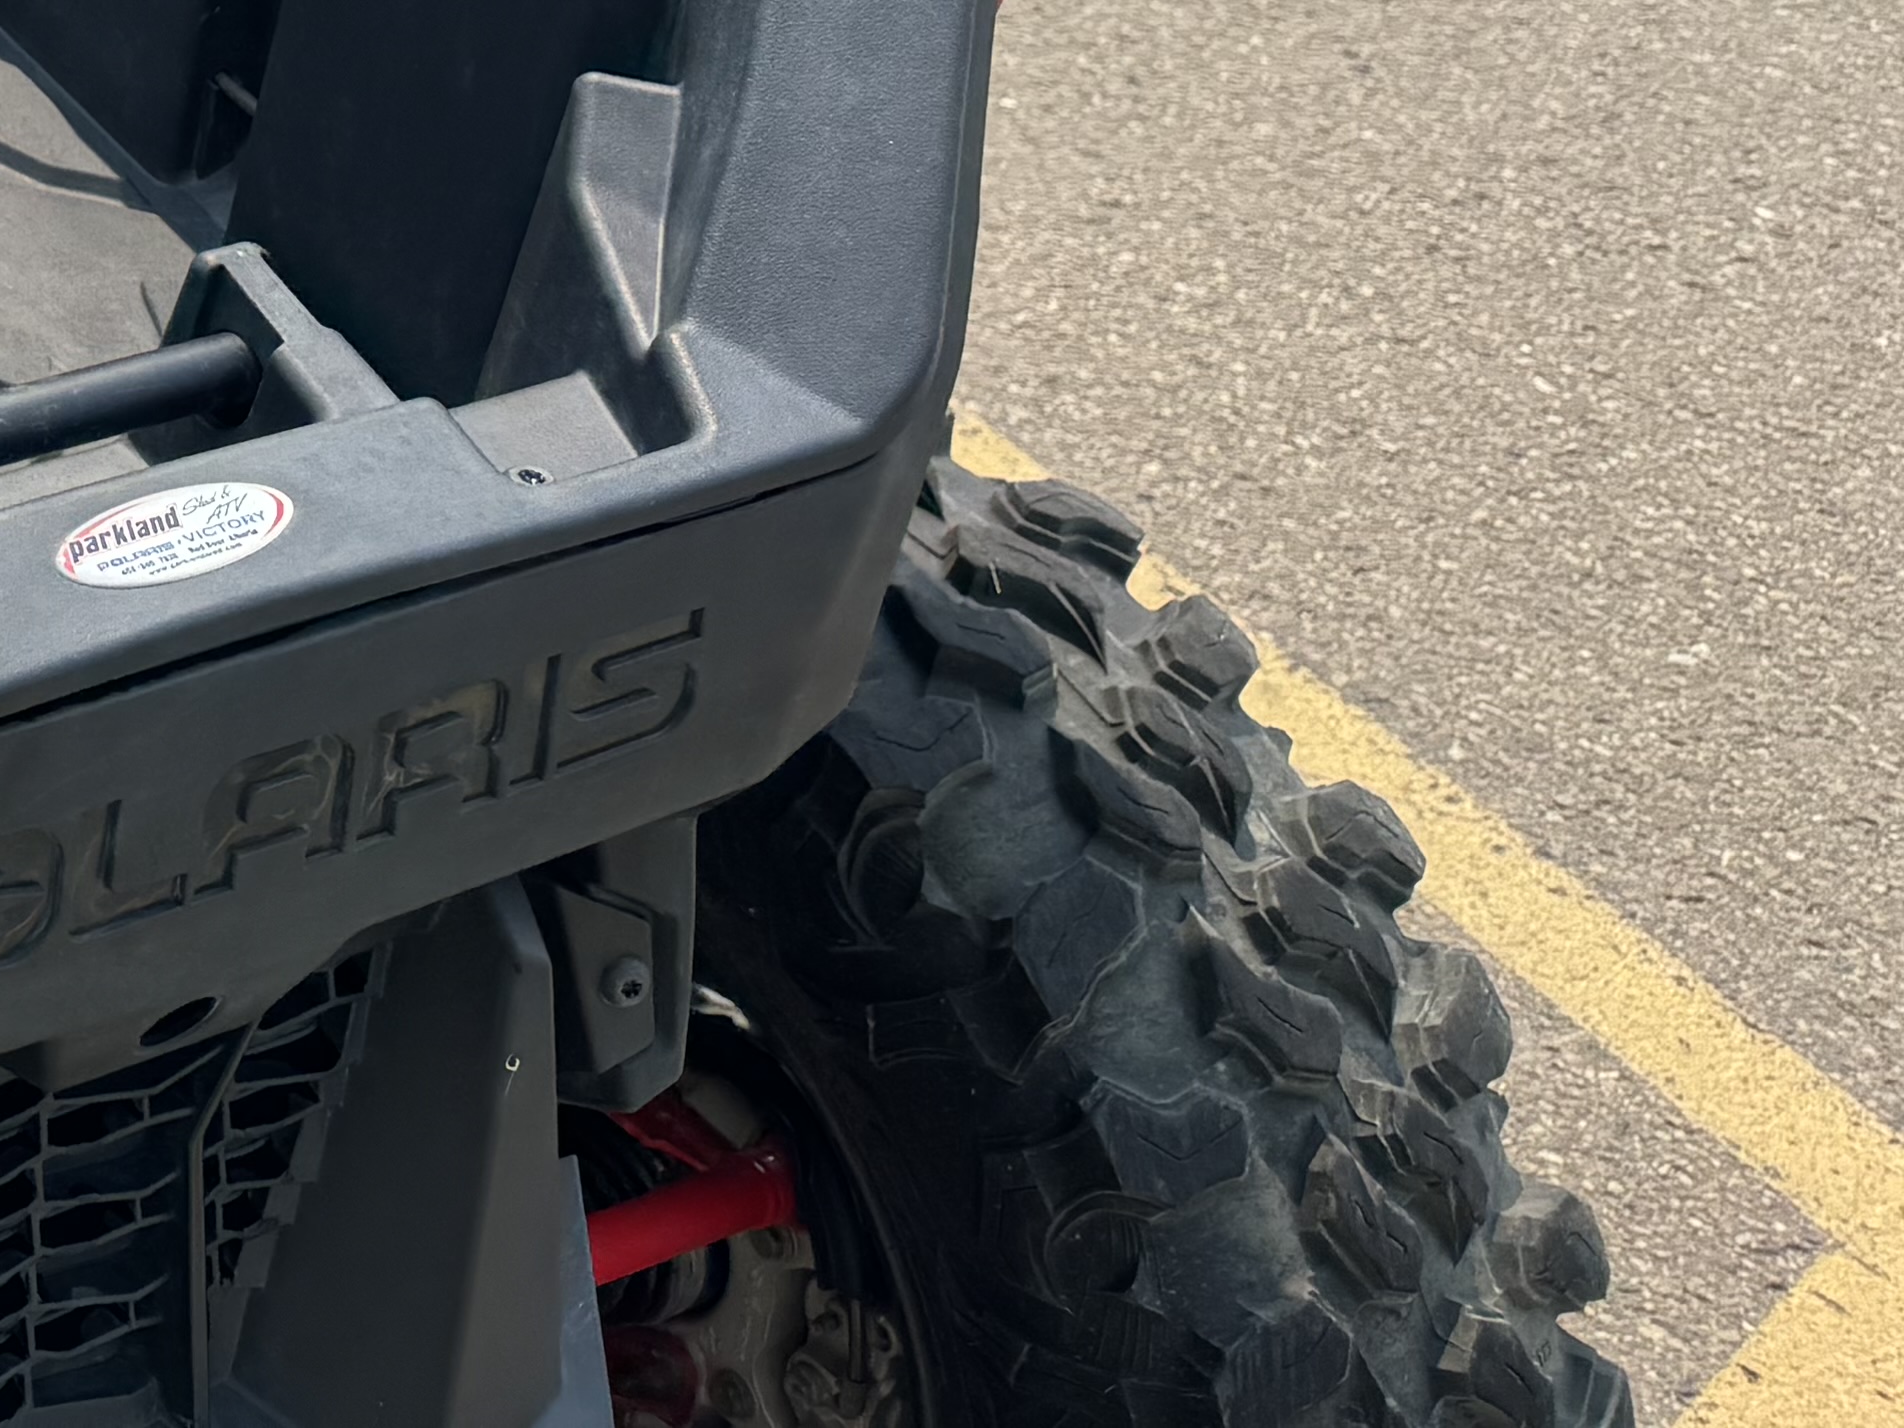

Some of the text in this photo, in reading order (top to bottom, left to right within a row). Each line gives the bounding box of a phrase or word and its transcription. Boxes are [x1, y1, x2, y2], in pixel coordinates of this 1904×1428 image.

[206, 492, 248, 525] ATV
[69, 506, 180, 563] parkland
[182, 510, 264, 542] VICTORY
